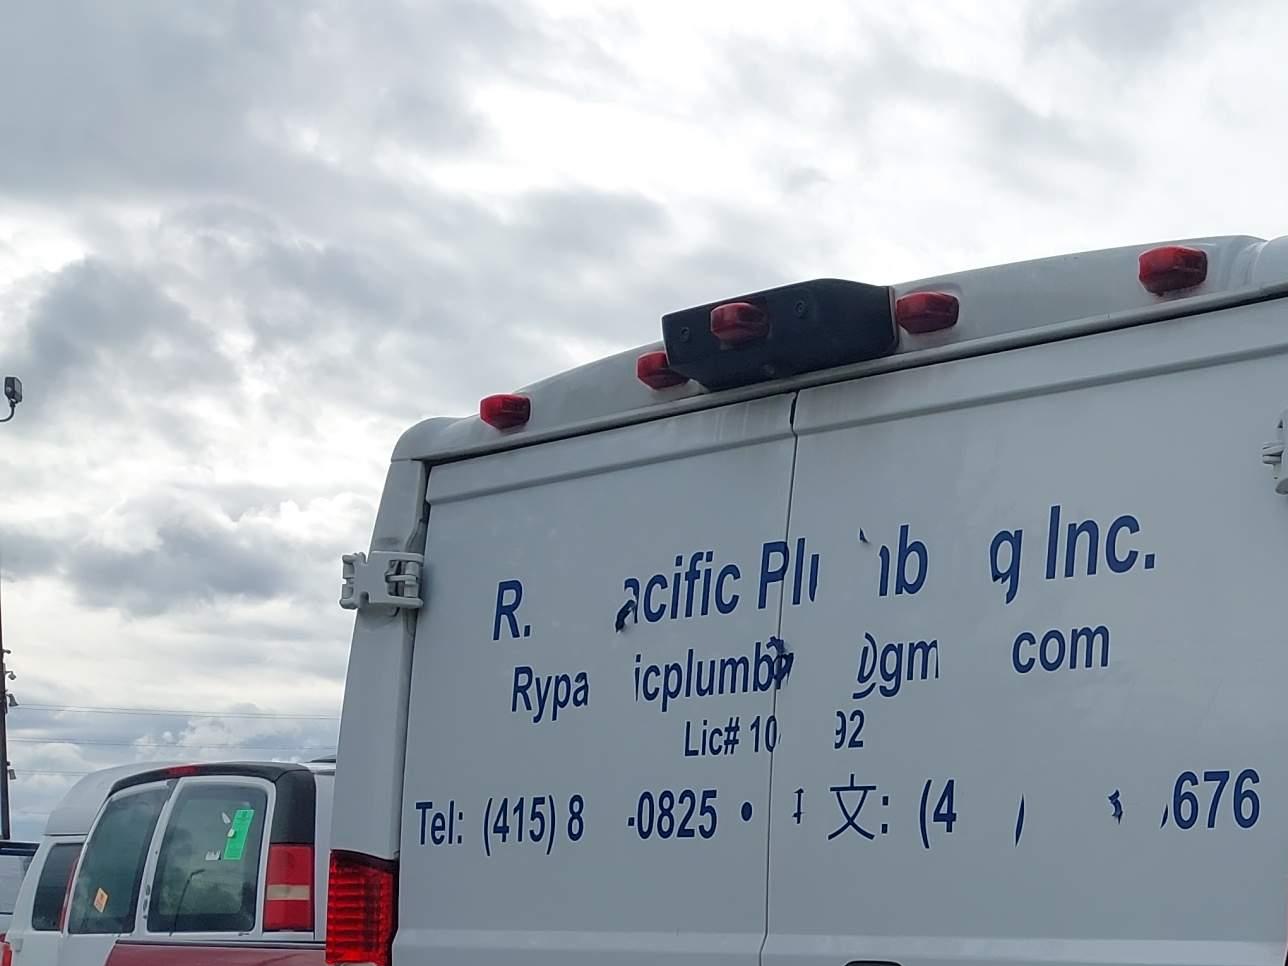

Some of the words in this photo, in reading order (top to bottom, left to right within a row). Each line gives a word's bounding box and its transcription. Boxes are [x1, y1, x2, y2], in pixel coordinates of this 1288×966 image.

[492, 579, 531, 641] R.
[615, 550, 741, 633] acific
[1045, 505, 1156, 580] Inc.
[684, 716, 740, 757] Lic#
[415, 800, 464, 846] Tel:
[483, 795, 556, 857] (415)
[567, 793, 718, 841] 8-0825
[1160, 768, 1260, 830] 676
